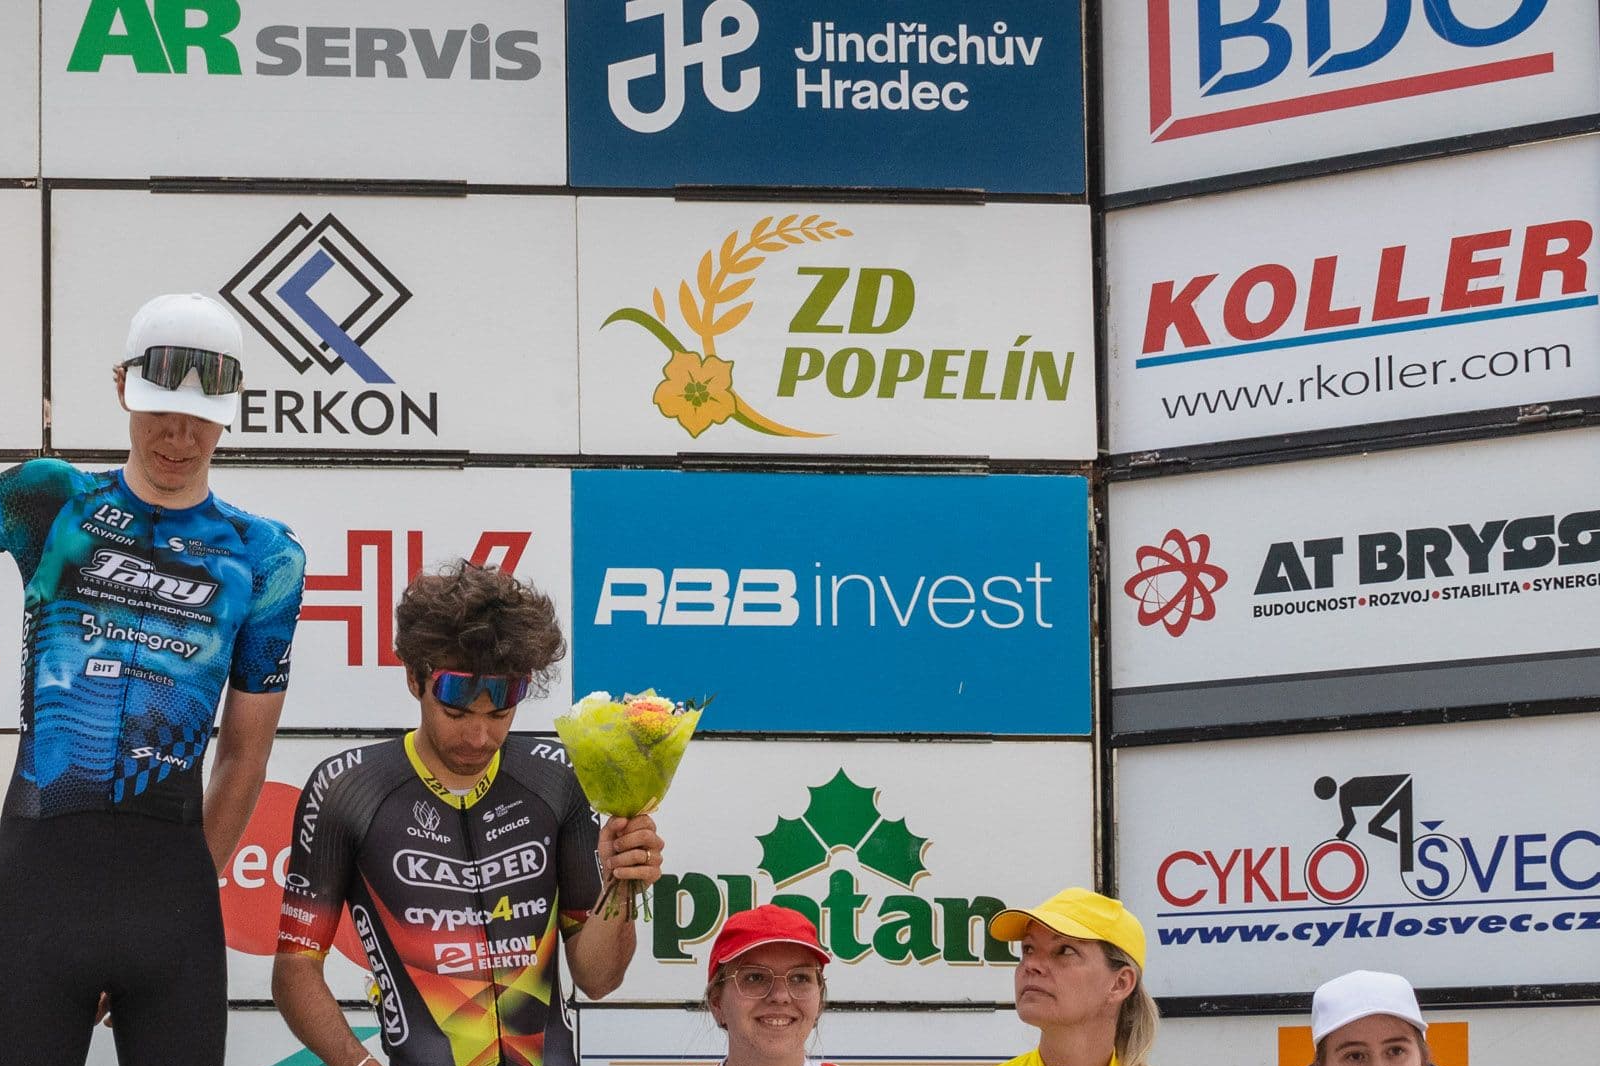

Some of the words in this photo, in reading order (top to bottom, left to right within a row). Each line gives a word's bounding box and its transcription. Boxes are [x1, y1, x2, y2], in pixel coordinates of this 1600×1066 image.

[66, 0, 242, 75] AR
[794, 22, 1043, 66] Jindřichův
[796, 69, 969, 112] Hradec
[789, 267, 915, 334] ZD
[1142, 219, 1594, 354] KOLLER
[777, 335, 1075, 401] POPELÍN
[1162, 343, 1572, 419] www.rkoller.com
[218, 390, 438, 436] ERKON
[82, 522, 136, 546] RAYMON
[94, 505, 133, 529] L27
[1253, 537, 1343, 595] AT
[100, 592, 126, 603] PRO
[128, 599, 212, 623] GASTRONOMII
[594, 568, 799, 626] RBB
[815, 562, 1053, 628] invest
[1253, 597, 1357, 618] BUDOUCNOST
[1369, 590, 1430, 607] ROZVOJ
[1442, 581, 1520, 600] STABILITA
[106, 623, 199, 658] integray
[93, 662, 114, 674] BIT
[124, 665, 175, 687] markets
[300, 750, 362, 854] RAYMON
[407, 827, 451, 844] OLYMP
[407, 850, 539, 889] KASPER
[1156, 841, 1367, 907] CYKLO
[1415, 820, 1600, 898] ŠVEC
[285, 885, 317, 899] KLEY
[404, 895, 548, 931] crypto4me
[1157, 908, 1600, 946] www.cyklosvec.cz
[355, 914, 401, 1035] KASPER
[479, 954, 538, 971] ELEKTRO
